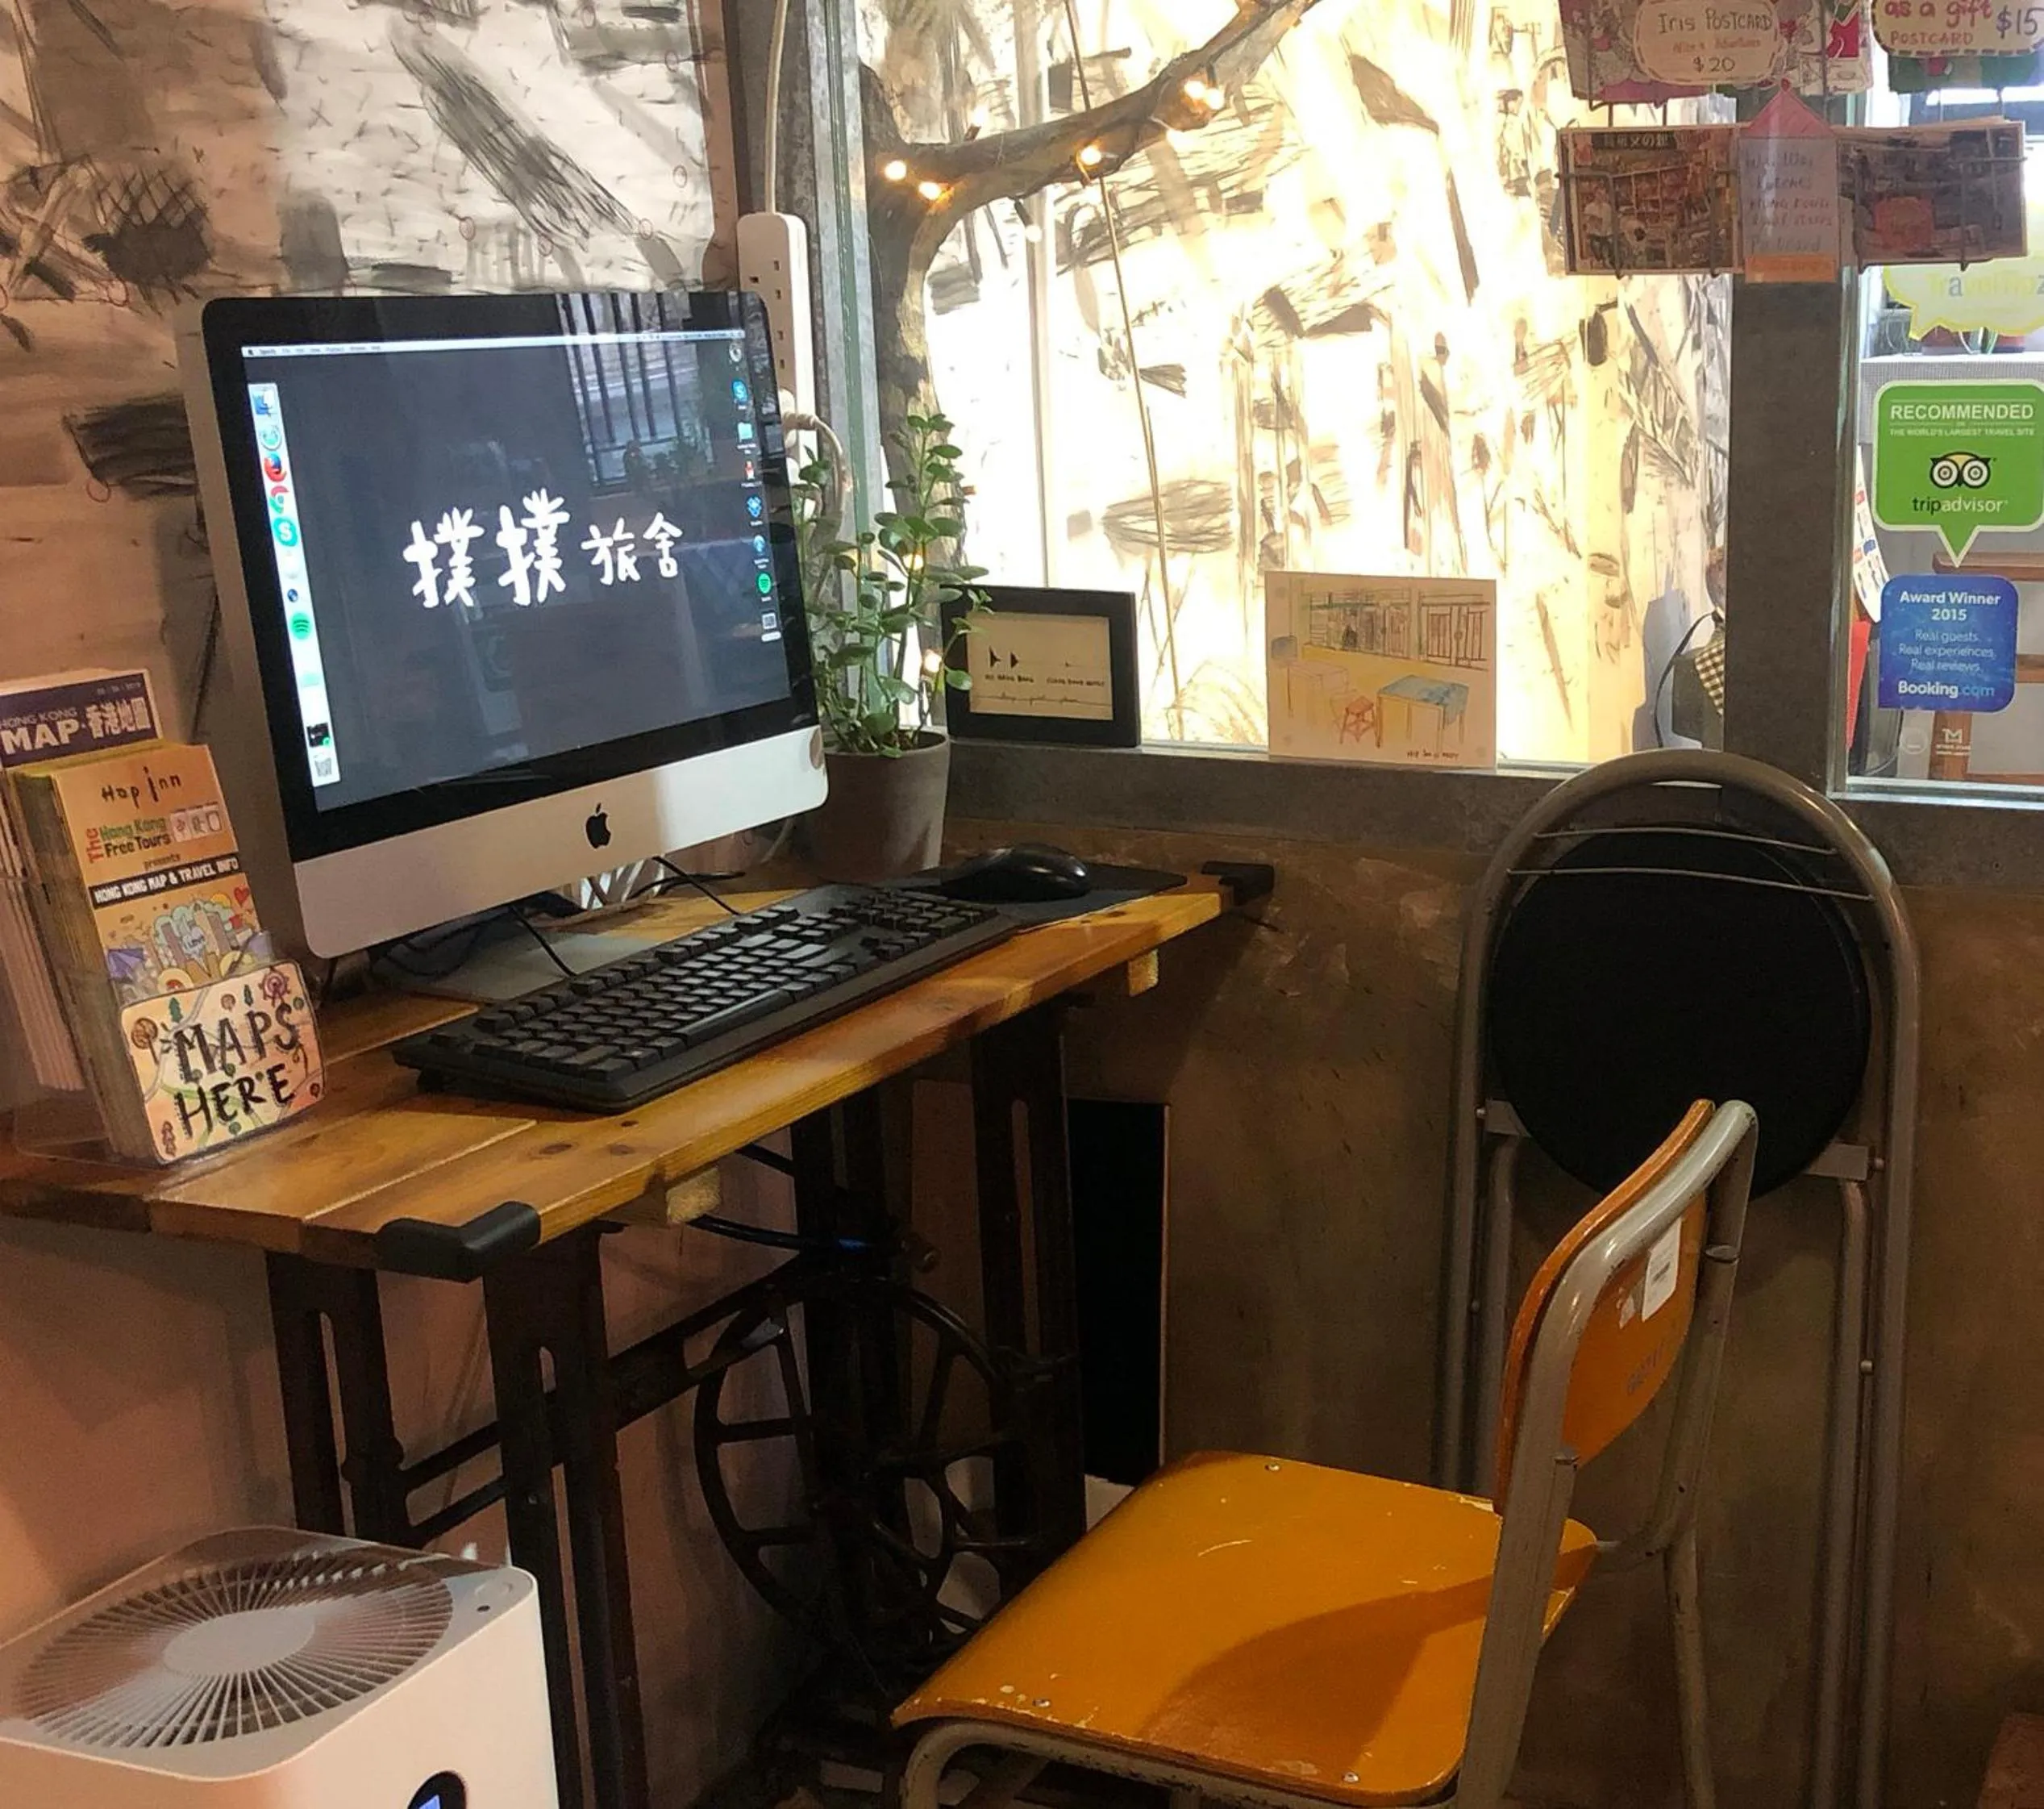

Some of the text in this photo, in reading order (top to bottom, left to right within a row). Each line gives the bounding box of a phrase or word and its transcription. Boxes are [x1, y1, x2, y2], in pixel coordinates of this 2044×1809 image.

[1884, 0, 1992, 28] as a gift
[1996, 5, 2044, 39] $15
[1890, 404, 2034, 419] RECOMMENDED
[1913, 496, 2004, 515] tripadvisor
[1900, 591, 2001, 605] Award Winner
[1932, 608, 1967, 621] 2015
[1915, 629, 1938, 641] Real
[1899, 644, 1922, 655] Real
[1911, 658, 1934, 671] Real
[1898, 681, 1995, 698] Booking.com
[39, 707, 77, 721] KONG
[1, 719, 80, 755] MAP
[102, 785, 139, 809] Hop
[99, 816, 165, 840] Hong Kong
[86, 827, 104, 864] The
[105, 833, 171, 858] Free Tours
[94, 858, 239, 903] HONG KONG MAP & TRAVEL INFO
[173, 1002, 301, 1084] MAPS
[175, 1063, 295, 1140] HERE
